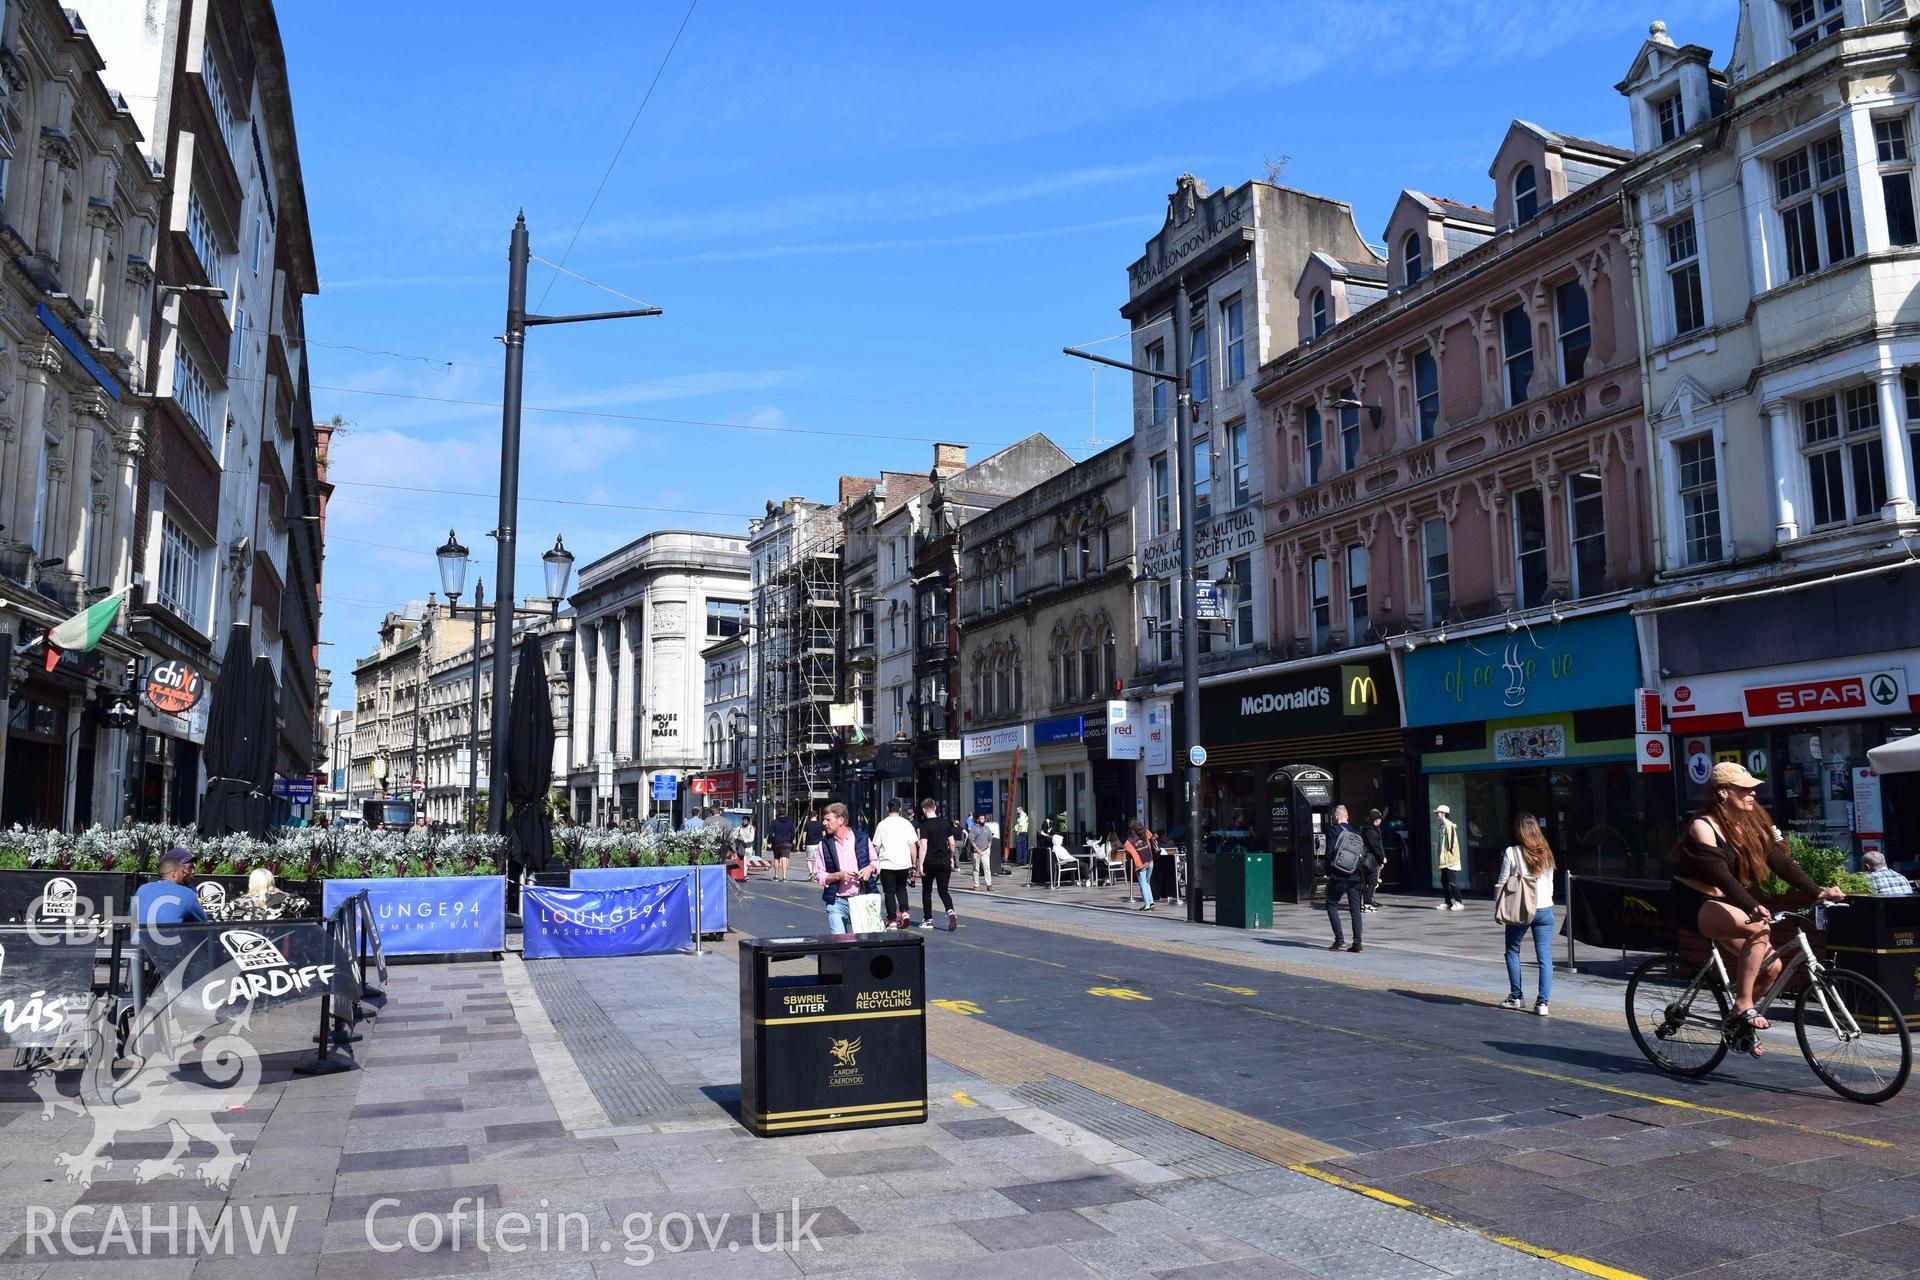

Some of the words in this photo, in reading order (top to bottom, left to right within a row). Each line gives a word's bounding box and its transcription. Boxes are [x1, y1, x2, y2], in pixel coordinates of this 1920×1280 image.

[1137, 262, 1163, 289] ROYAL
[1165, 231, 1206, 270] LONDON
[1144, 539, 1169, 560] ROYAL
[1172, 528, 1208, 551] LOON
[1213, 511, 1255, 537] MUTUAL
[1238, 530, 1257, 548] LTD.
[1240, 686, 1330, 716] McDonald's
[1776, 684, 1863, 709] SPAR
[652, 713, 678, 721] HOUSE
[658, 721, 669, 729] OF
[1114, 724, 1132, 735] red
[651, 729, 678, 737] FRASER
[971, 735, 992, 748] TESCO
[993, 730, 1018, 748] express
[1150, 730, 1161, 742] red
[1271, 804, 1289, 816] cash
[379, 901, 480, 918] UNGE94
[541, 902, 667, 924] LOUNGE94
[379, 921, 437, 932] EMENT
[450, 918, 480, 929] BAR
[542, 926, 627, 936] BASEMENT
[640, 920, 668, 931] BAR
[236, 951, 278, 961] TACO
[244, 957, 284, 967] BELL
[783, 993, 829, 1005] SBWRIEL
[856, 989, 911, 1001] AILGYLCHU
[789, 1003, 825, 1014] LITTER
[856, 998, 912, 1009] RECYCLING
[833, 1067, 859, 1076] CARDIFF
[829, 1076, 863, 1085] CAERDYDD
